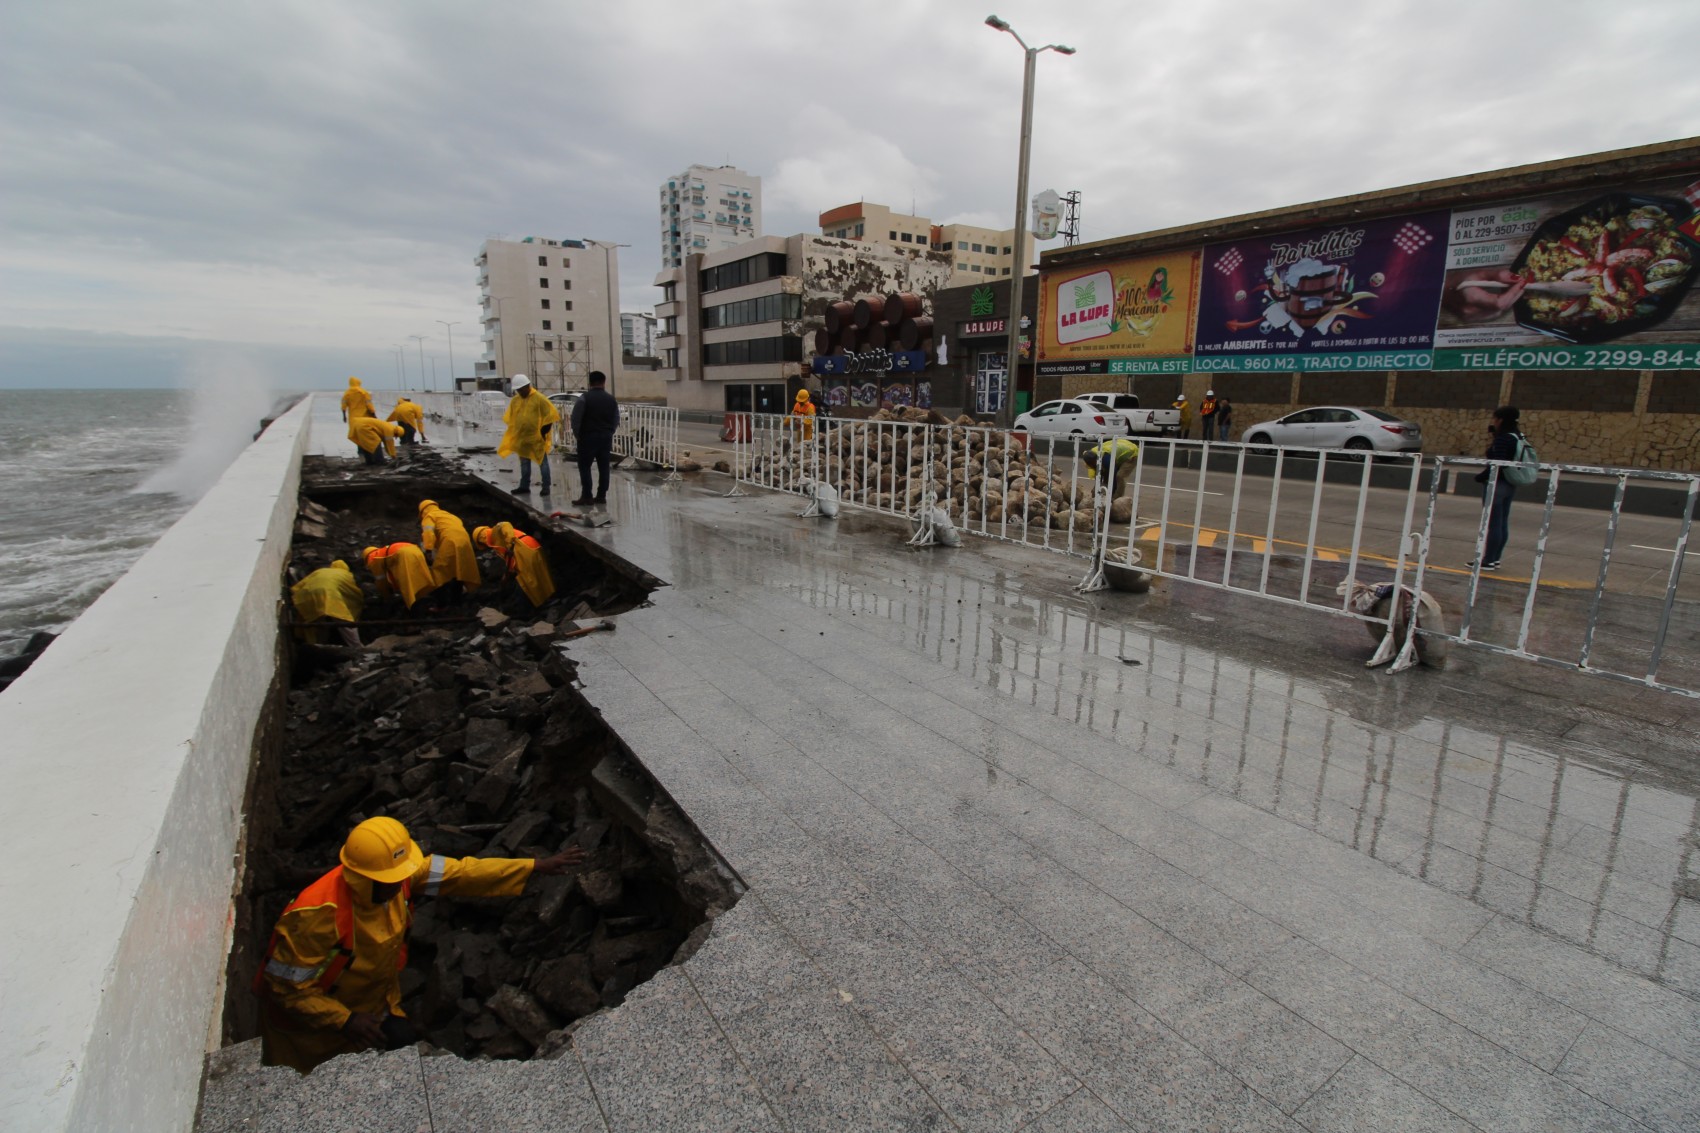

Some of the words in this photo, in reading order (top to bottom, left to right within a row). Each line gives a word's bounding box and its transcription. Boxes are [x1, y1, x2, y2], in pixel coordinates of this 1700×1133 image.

[1456, 217, 1475, 229] PÍDE
[1477, 215, 1495, 226] POR
[1502, 208, 1538, 223] eats
[1463, 230, 1473, 239] AL
[1475, 222, 1536, 238] 229-9507-132
[1271, 227, 1365, 268] Barrilitos
[1329, 248, 1355, 260] BEER
[1472, 244, 1506, 255] SERVICIO
[1456, 258, 1460, 266] A
[1462, 254, 1500, 266] DOMICILIO
[1061, 312, 1077, 327] LA
[1079, 304, 1109, 323] LUPE
[1115, 304, 1159, 320] Mexicana
[965, 322, 978, 333] LA
[979, 320, 1004, 332] LUPE
[1223, 339, 1267, 350] AMBIENTE
[1311, 340, 1329, 348] MARTES
[1330, 339, 1334, 347] A
[1335, 338, 1357, 347] DOMINGO
[1363, 337, 1379, 345] PARTIR
[1388, 336, 1398, 344] LAS
[1196, 359, 1240, 371] LOCAL,
[1244, 358, 1271, 369] 960
[1274, 357, 1298, 369] M2.
[1302, 355, 1352, 369] TRATO
[1356, 353, 1431, 368] DIRECTO
[1461, 348, 1576, 367] TELÉFONO:
[1111, 362, 1124, 372] SE
[1125, 361, 1159, 372] RENTA
[1162, 361, 1189, 371] ESTE
